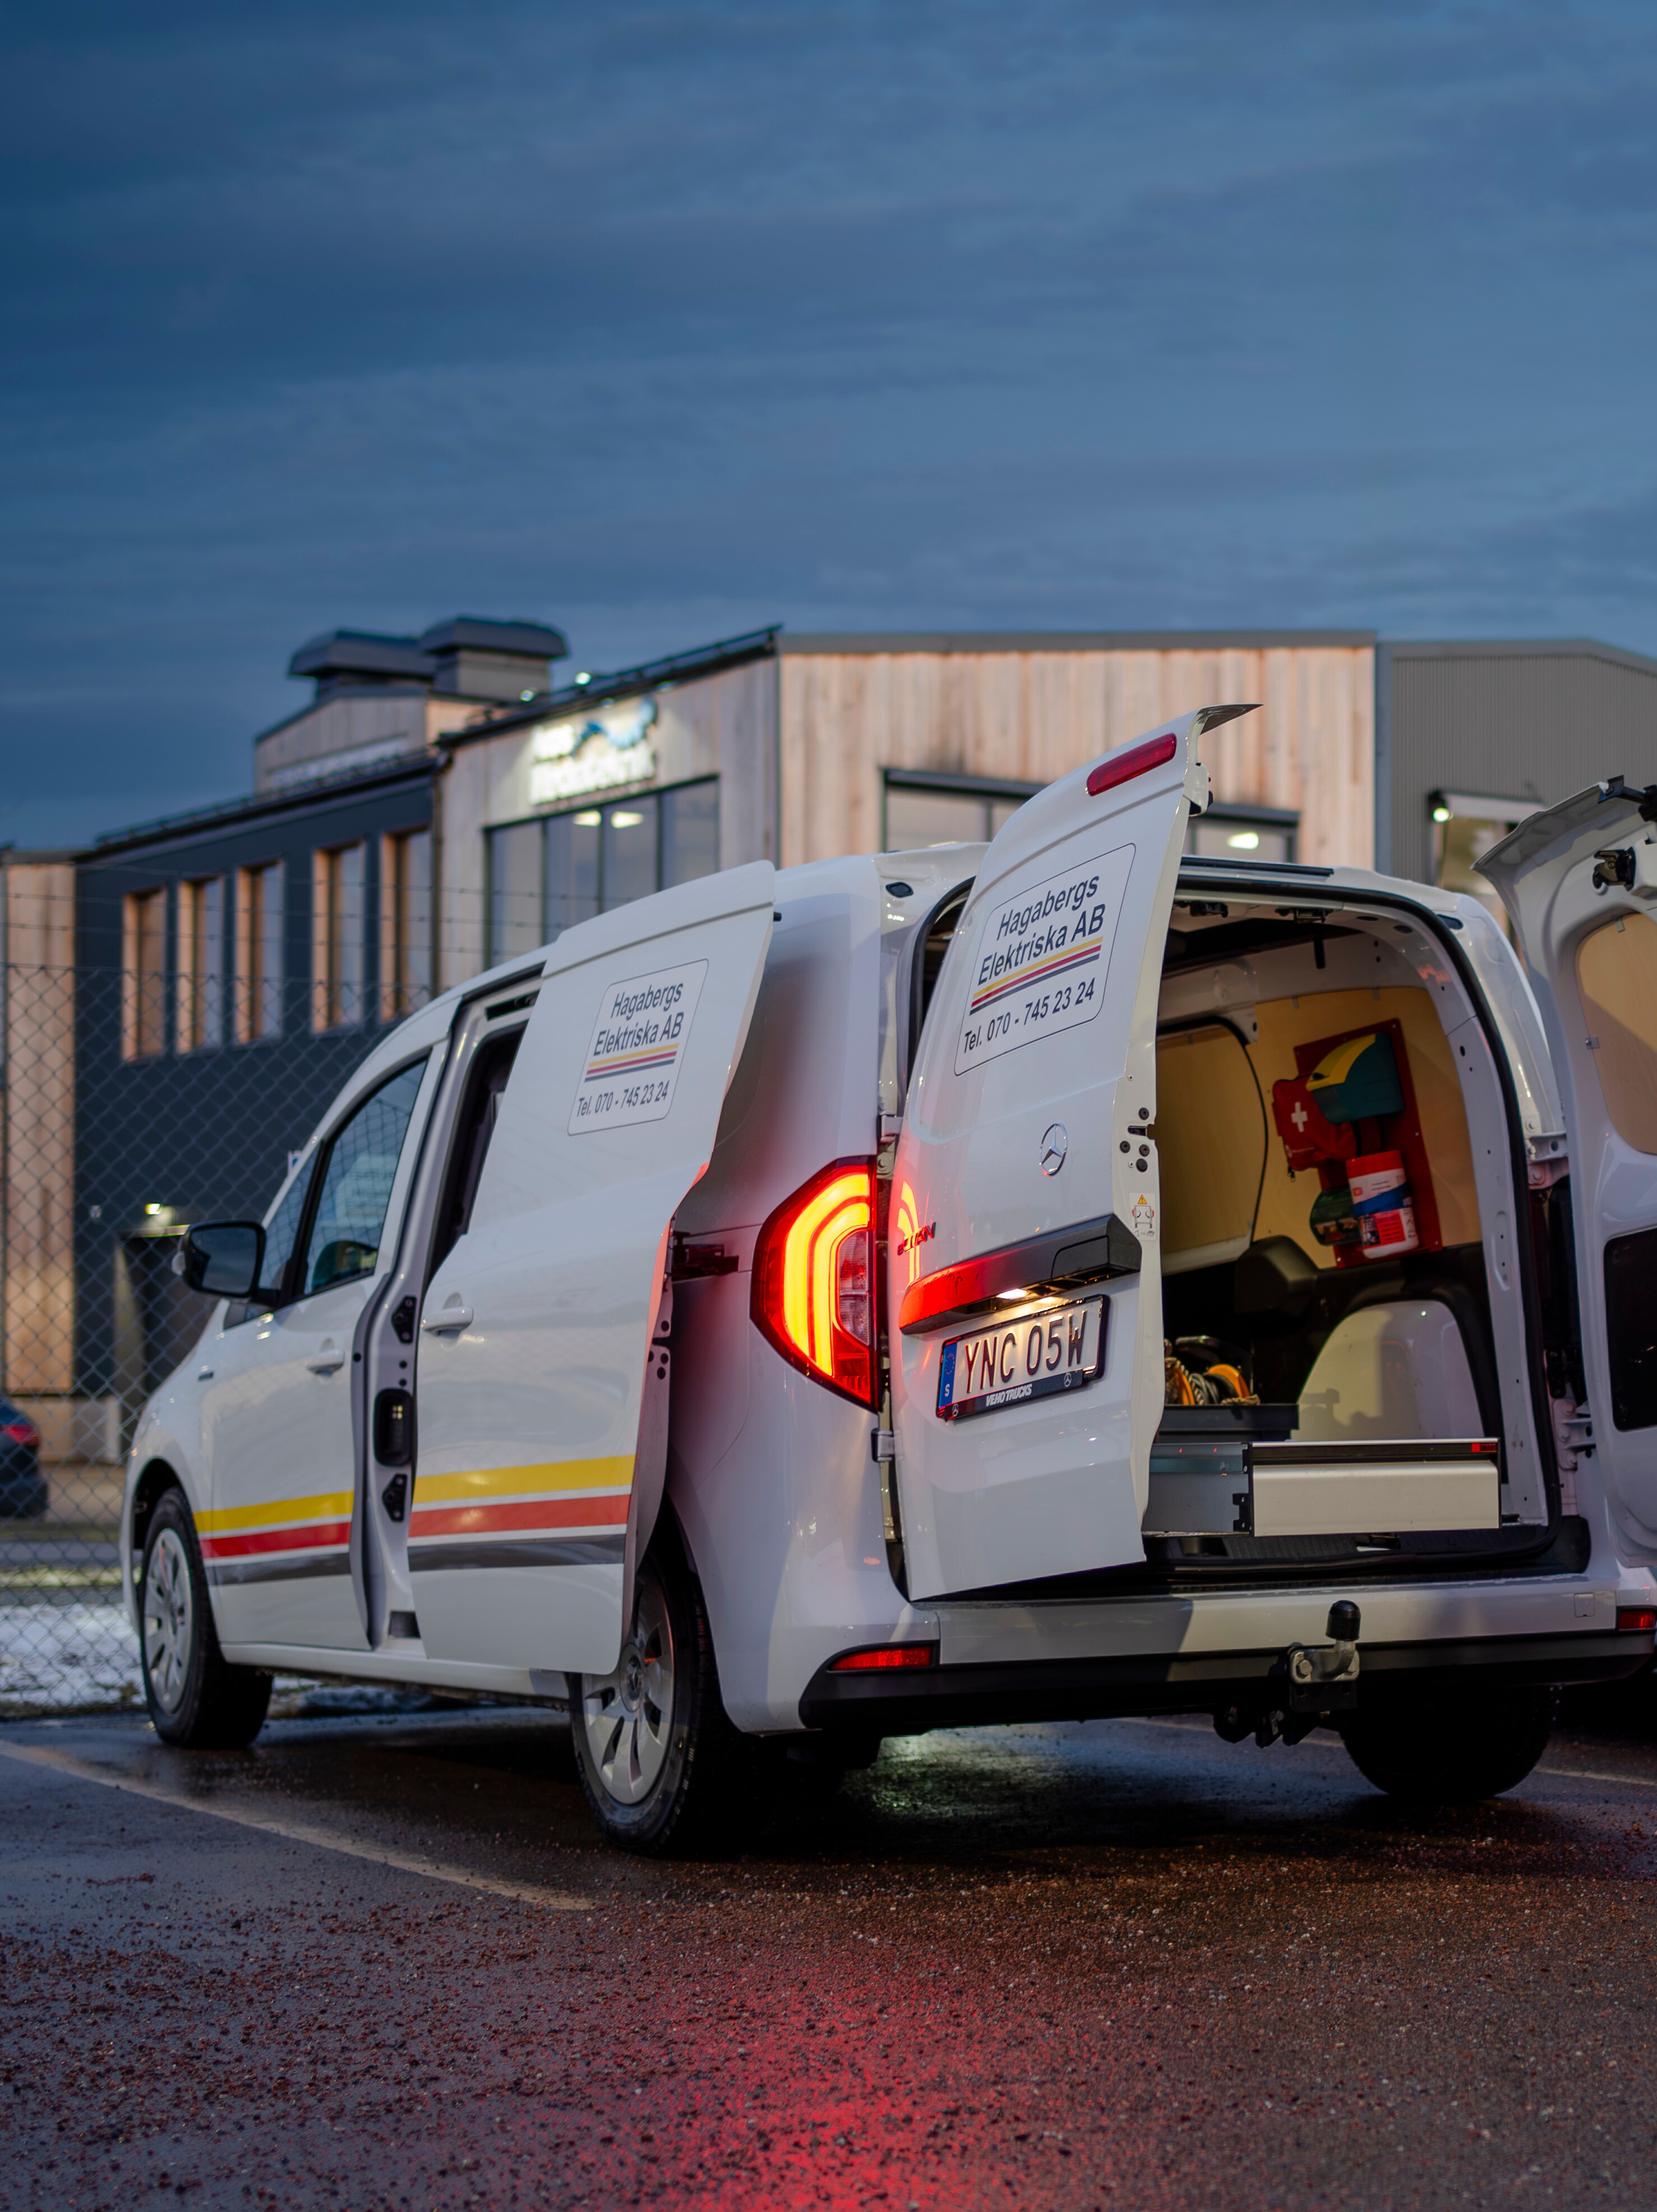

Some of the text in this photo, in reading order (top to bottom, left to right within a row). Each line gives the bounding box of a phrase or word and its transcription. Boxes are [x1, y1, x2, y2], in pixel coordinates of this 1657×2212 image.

[996, 875, 1099, 941] Hagabergs
[978, 904, 1106, 986] Elektriska AB
[611, 983, 684, 1020] Hagabergs
[964, 1026, 982, 1053] Tel.
[987, 1012, 1011, 1042] 070
[1024, 995, 1050, 1026] 745
[1052, 987, 1072, 1014] 23
[1075, 978, 1096, 1006] 24
[593, 1012, 684, 1057] Elektriska AB
[576, 1097, 591, 1117] Tel.
[595, 1091, 613, 1113] 070
[621, 1086, 640, 1109] 745
[640, 1084, 655, 1105] 23
[655, 1080, 670, 1103] 24
[965, 1310, 1087, 1394] YNC 05W
[944, 1383, 950, 1397] S
